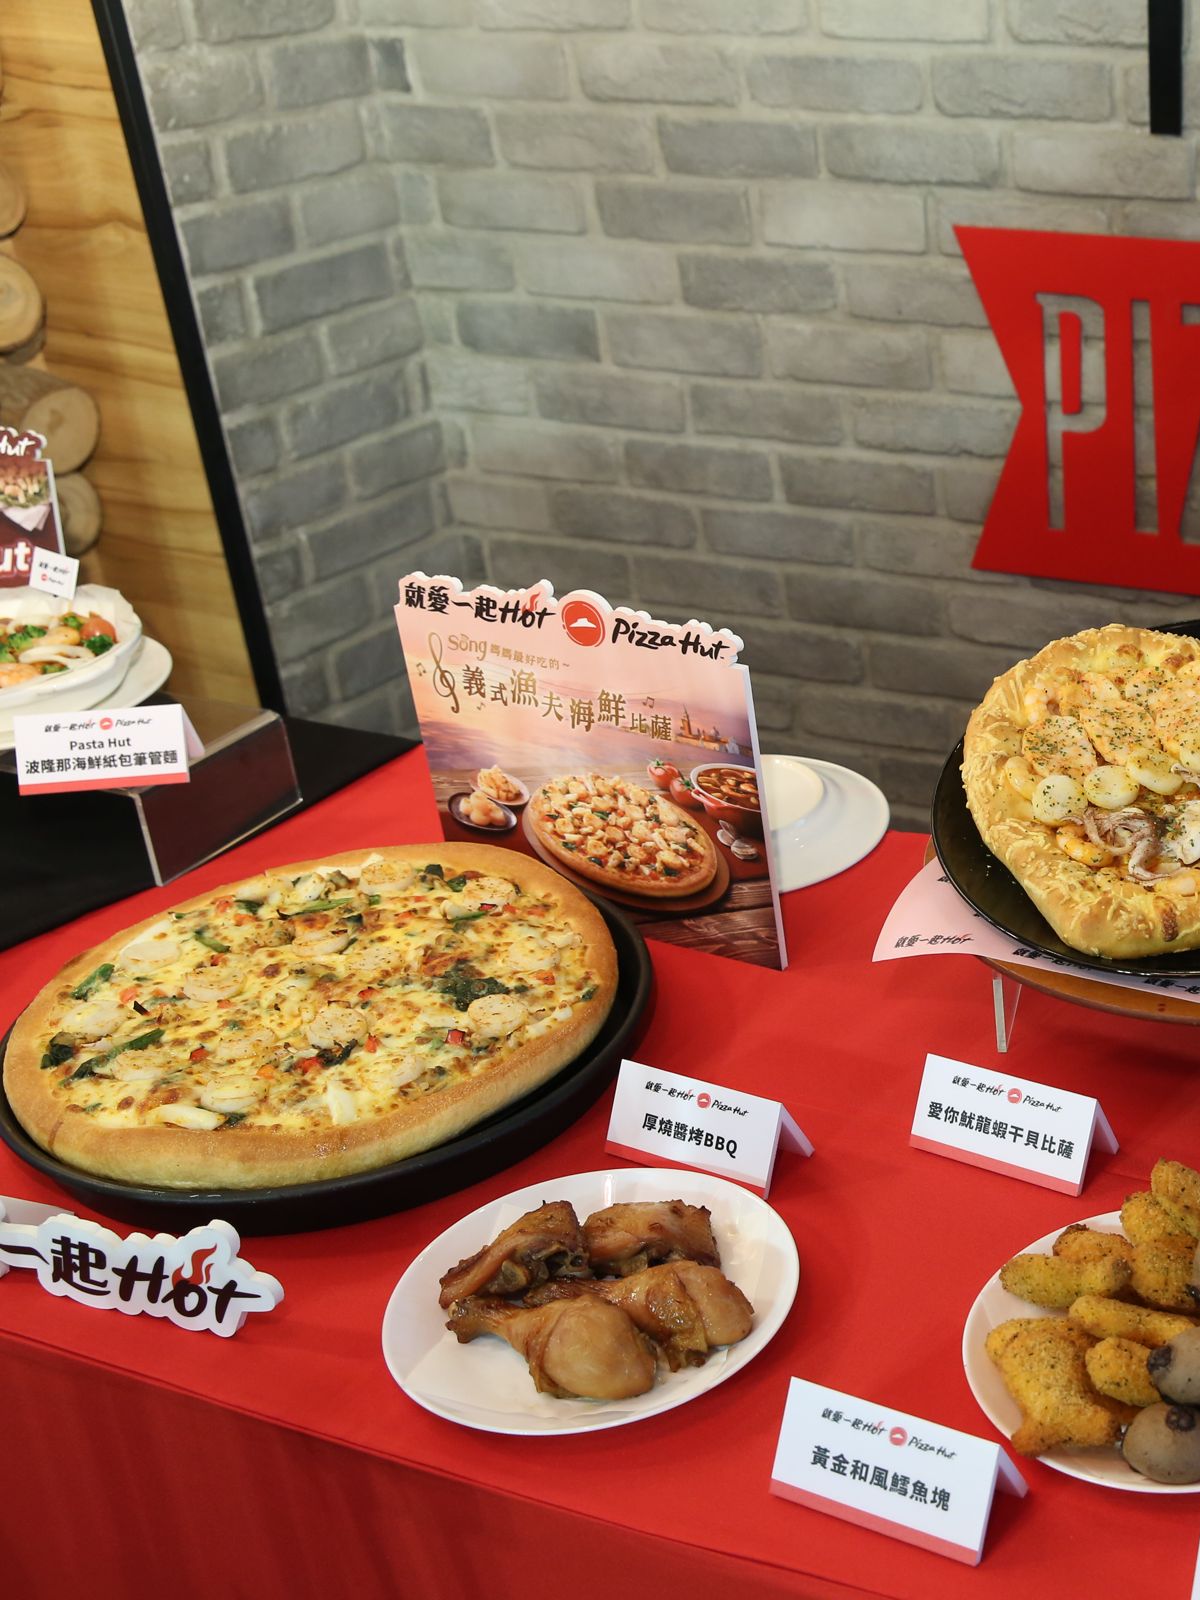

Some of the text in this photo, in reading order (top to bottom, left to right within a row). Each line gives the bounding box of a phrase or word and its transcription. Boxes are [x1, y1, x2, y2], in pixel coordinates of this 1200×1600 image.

[611, 617, 676, 649] Pizza
[678, 631, 730, 660] Hut
[463, 665, 673, 742] 義式漁夫海鮮比薩
[70, 737, 132, 751] Pasta Hut
[711, 1099, 732, 1112] Pizza
[733, 1106, 749, 1117] Hut
[1023, 1095, 1045, 1108] Pizza
[1046, 1102, 1062, 1113] Hut
[927, 1101, 1075, 1160] 愛你魷龍蝦干貝比薩
[907, 1436, 936, 1452] Pizza
[937, 1446, 957, 1459] Hut
[810, 1445, 951, 1512] 黃金和風鱈魚塊
